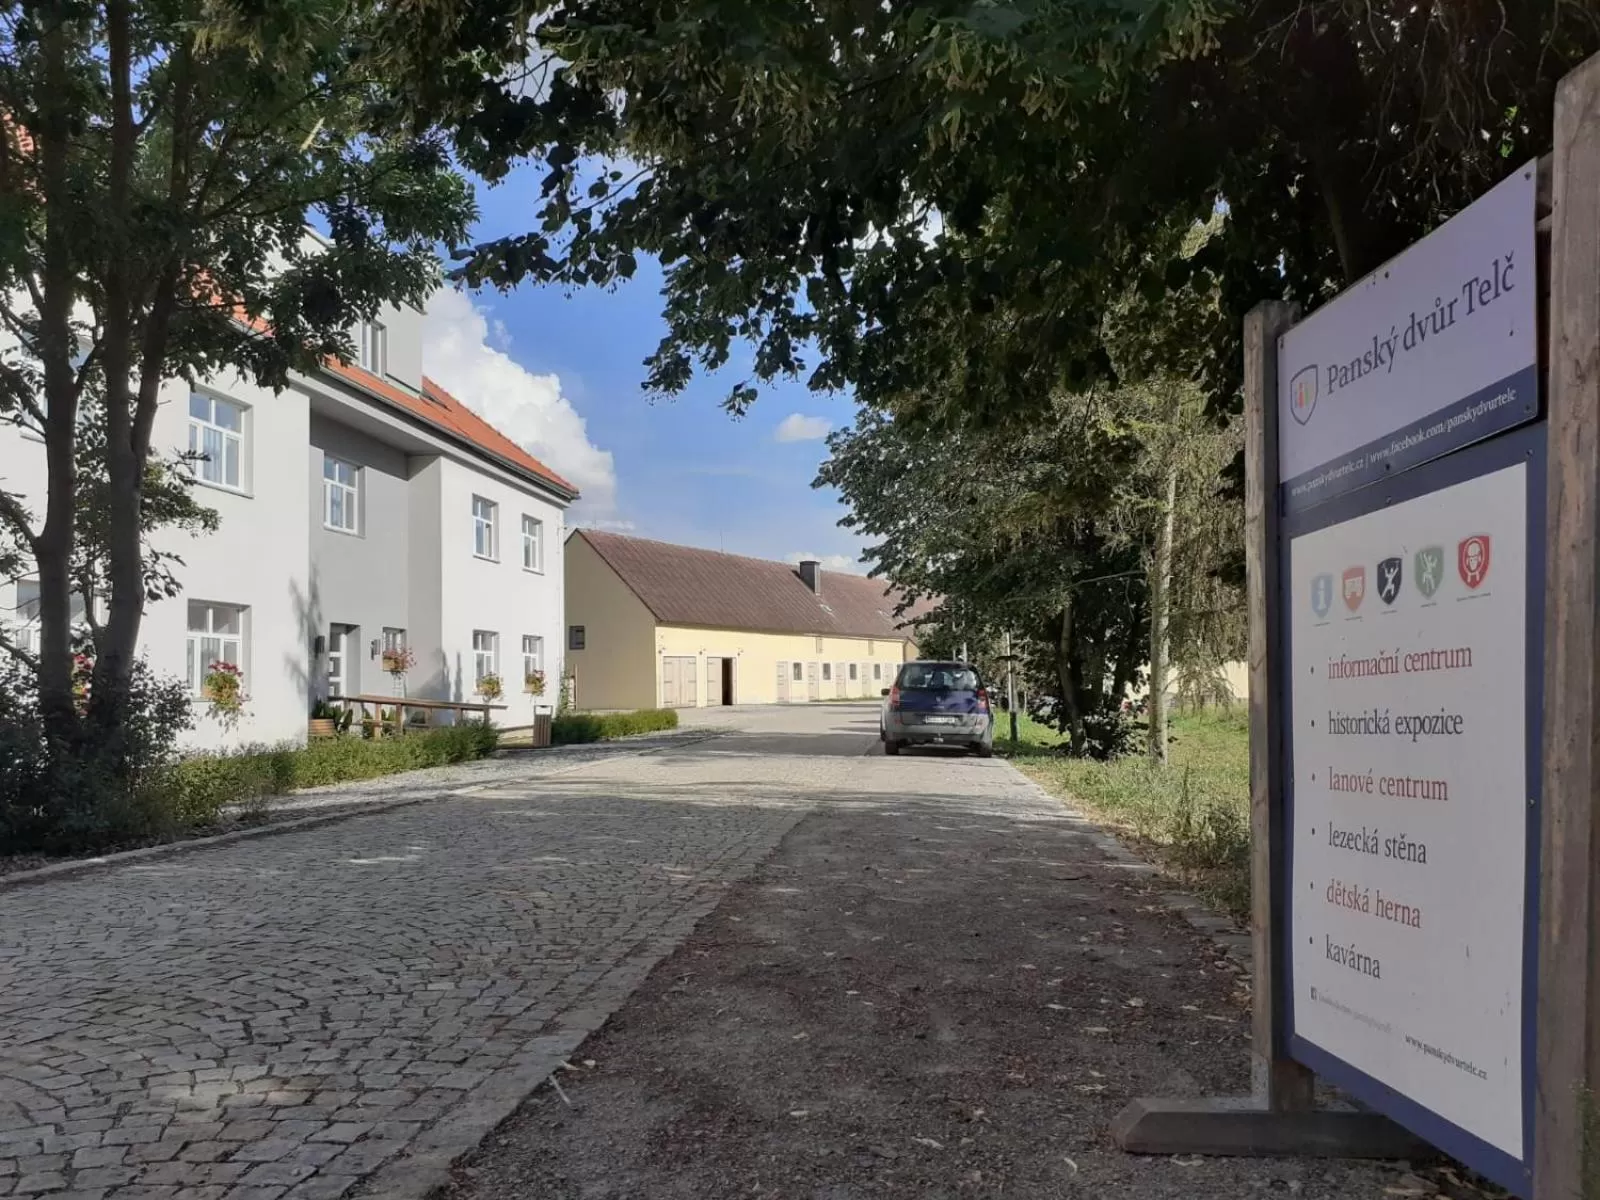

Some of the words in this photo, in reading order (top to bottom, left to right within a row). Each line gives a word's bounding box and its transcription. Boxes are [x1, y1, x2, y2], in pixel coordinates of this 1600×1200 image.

[1326, 325, 1398, 394] Panský
[1402, 296, 1458, 351] dvůr
[1462, 250, 1515, 317] Telč
[1369, 387, 1516, 463] www.facebook.com/panskydvurtelc
[1328, 647, 1400, 679] informační
[1404, 647, 1472, 673] centrum
[1328, 708, 1390, 735] historická
[1395, 707, 1463, 742] expozice
[1329, 766, 1373, 794] lanové
[1379, 775, 1448, 801] centrum
[1328, 821, 1378, 855] lezecká
[1384, 833, 1427, 864] stěna
[1326, 879, 1369, 913] dětská
[1375, 890, 1421, 928] herna
[1325, 933, 1381, 979] kavárna
